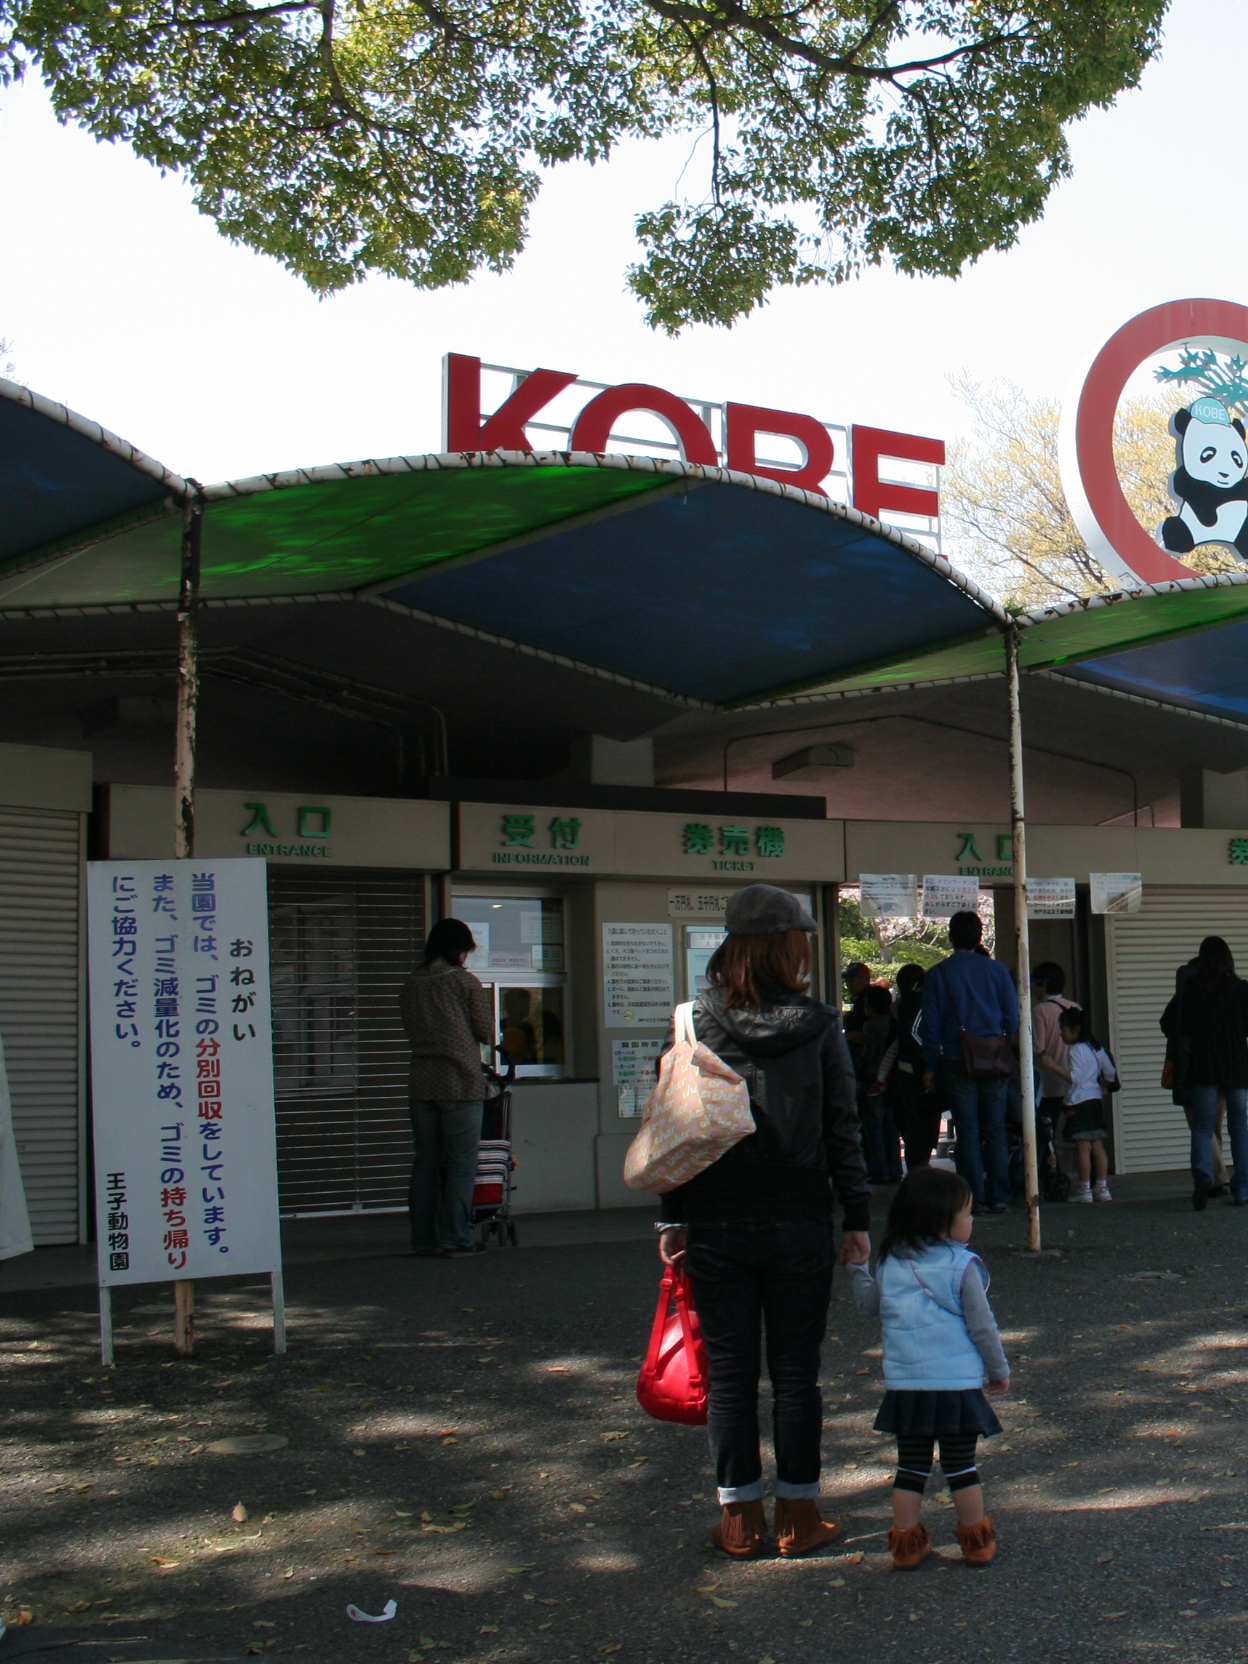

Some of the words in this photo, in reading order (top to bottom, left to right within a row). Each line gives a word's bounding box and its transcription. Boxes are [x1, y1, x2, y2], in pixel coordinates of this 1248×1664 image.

[1194, 404, 1226, 422] KOBE
[241, 801, 333, 839] 入口
[502, 814, 582, 850] 受付
[246, 843, 333, 858] ENTRANCE
[684, 823, 785, 857] 券売機
[492, 852, 590, 867] INFORMATION
[711, 859, 756, 872] TICKET
[111, 875, 141, 1048] にご協力ください。
[229, 938, 257, 1041] おねがい
[152, 874, 190, 1270] また、ゴミ減量化のため、ゴミの持ち帰り
[191, 872, 230, 1254] 当園では、ゴミの分別回収をしています。
[106, 1172, 130, 1271] 王子動物園
